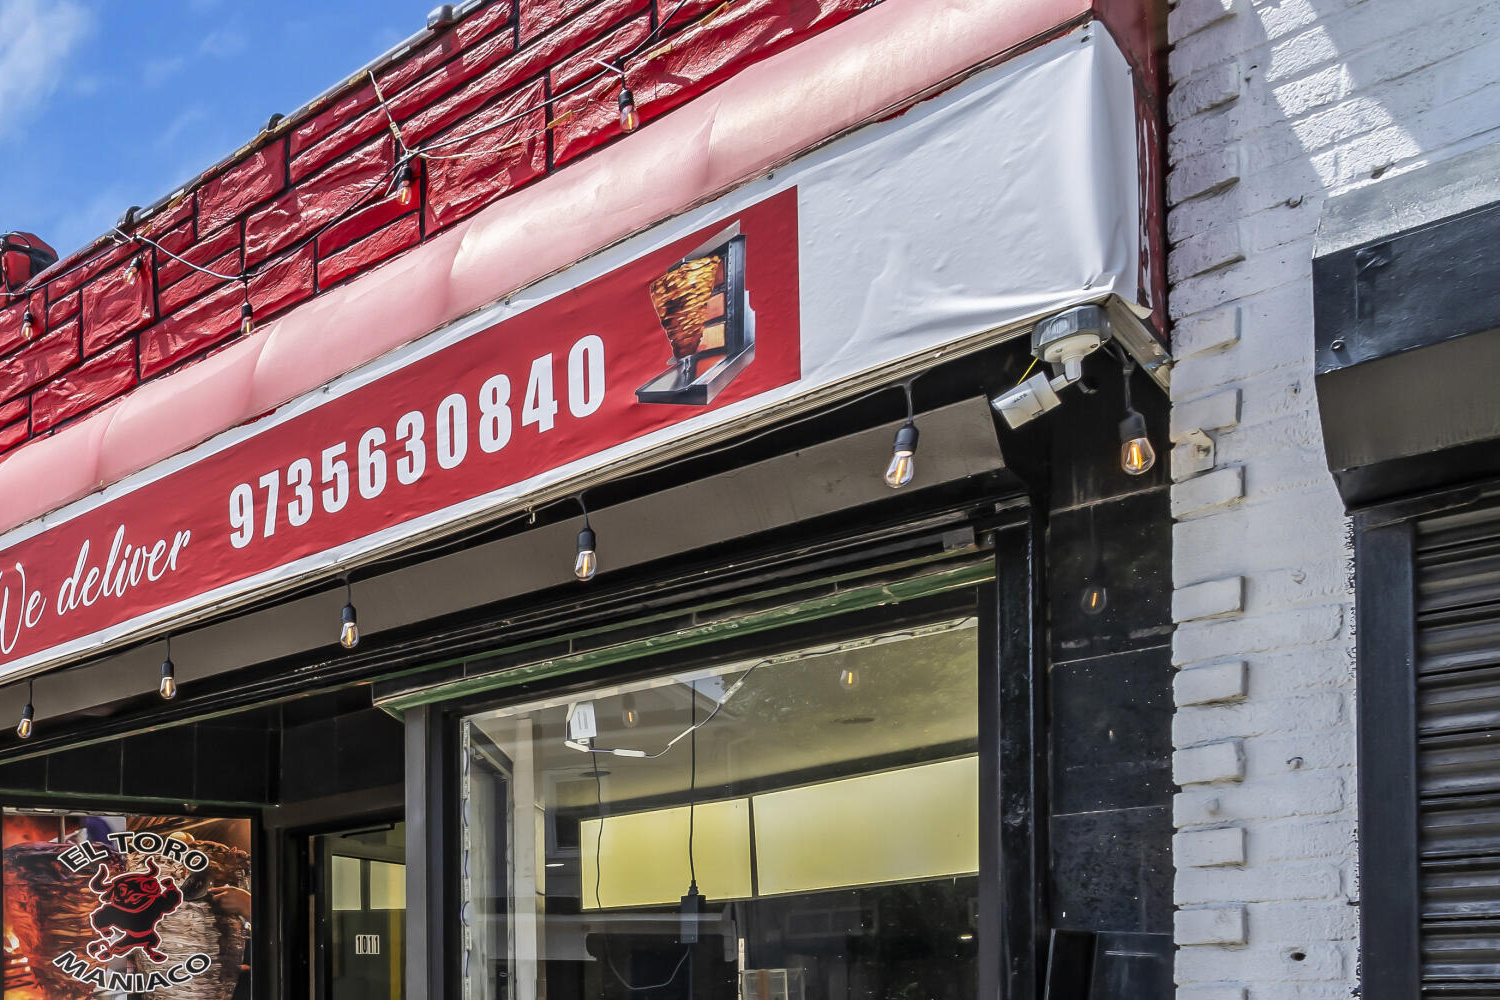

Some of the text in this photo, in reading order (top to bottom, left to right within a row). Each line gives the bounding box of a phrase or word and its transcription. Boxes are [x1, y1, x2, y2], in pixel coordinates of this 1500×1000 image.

[229, 334, 605, 549] 9735630840
[57, 524, 191, 616] deliver
[58, 832, 209, 872] EL TORO
[356, 935, 380, 954] 1011
[52, 951, 211, 992] MANIACO
